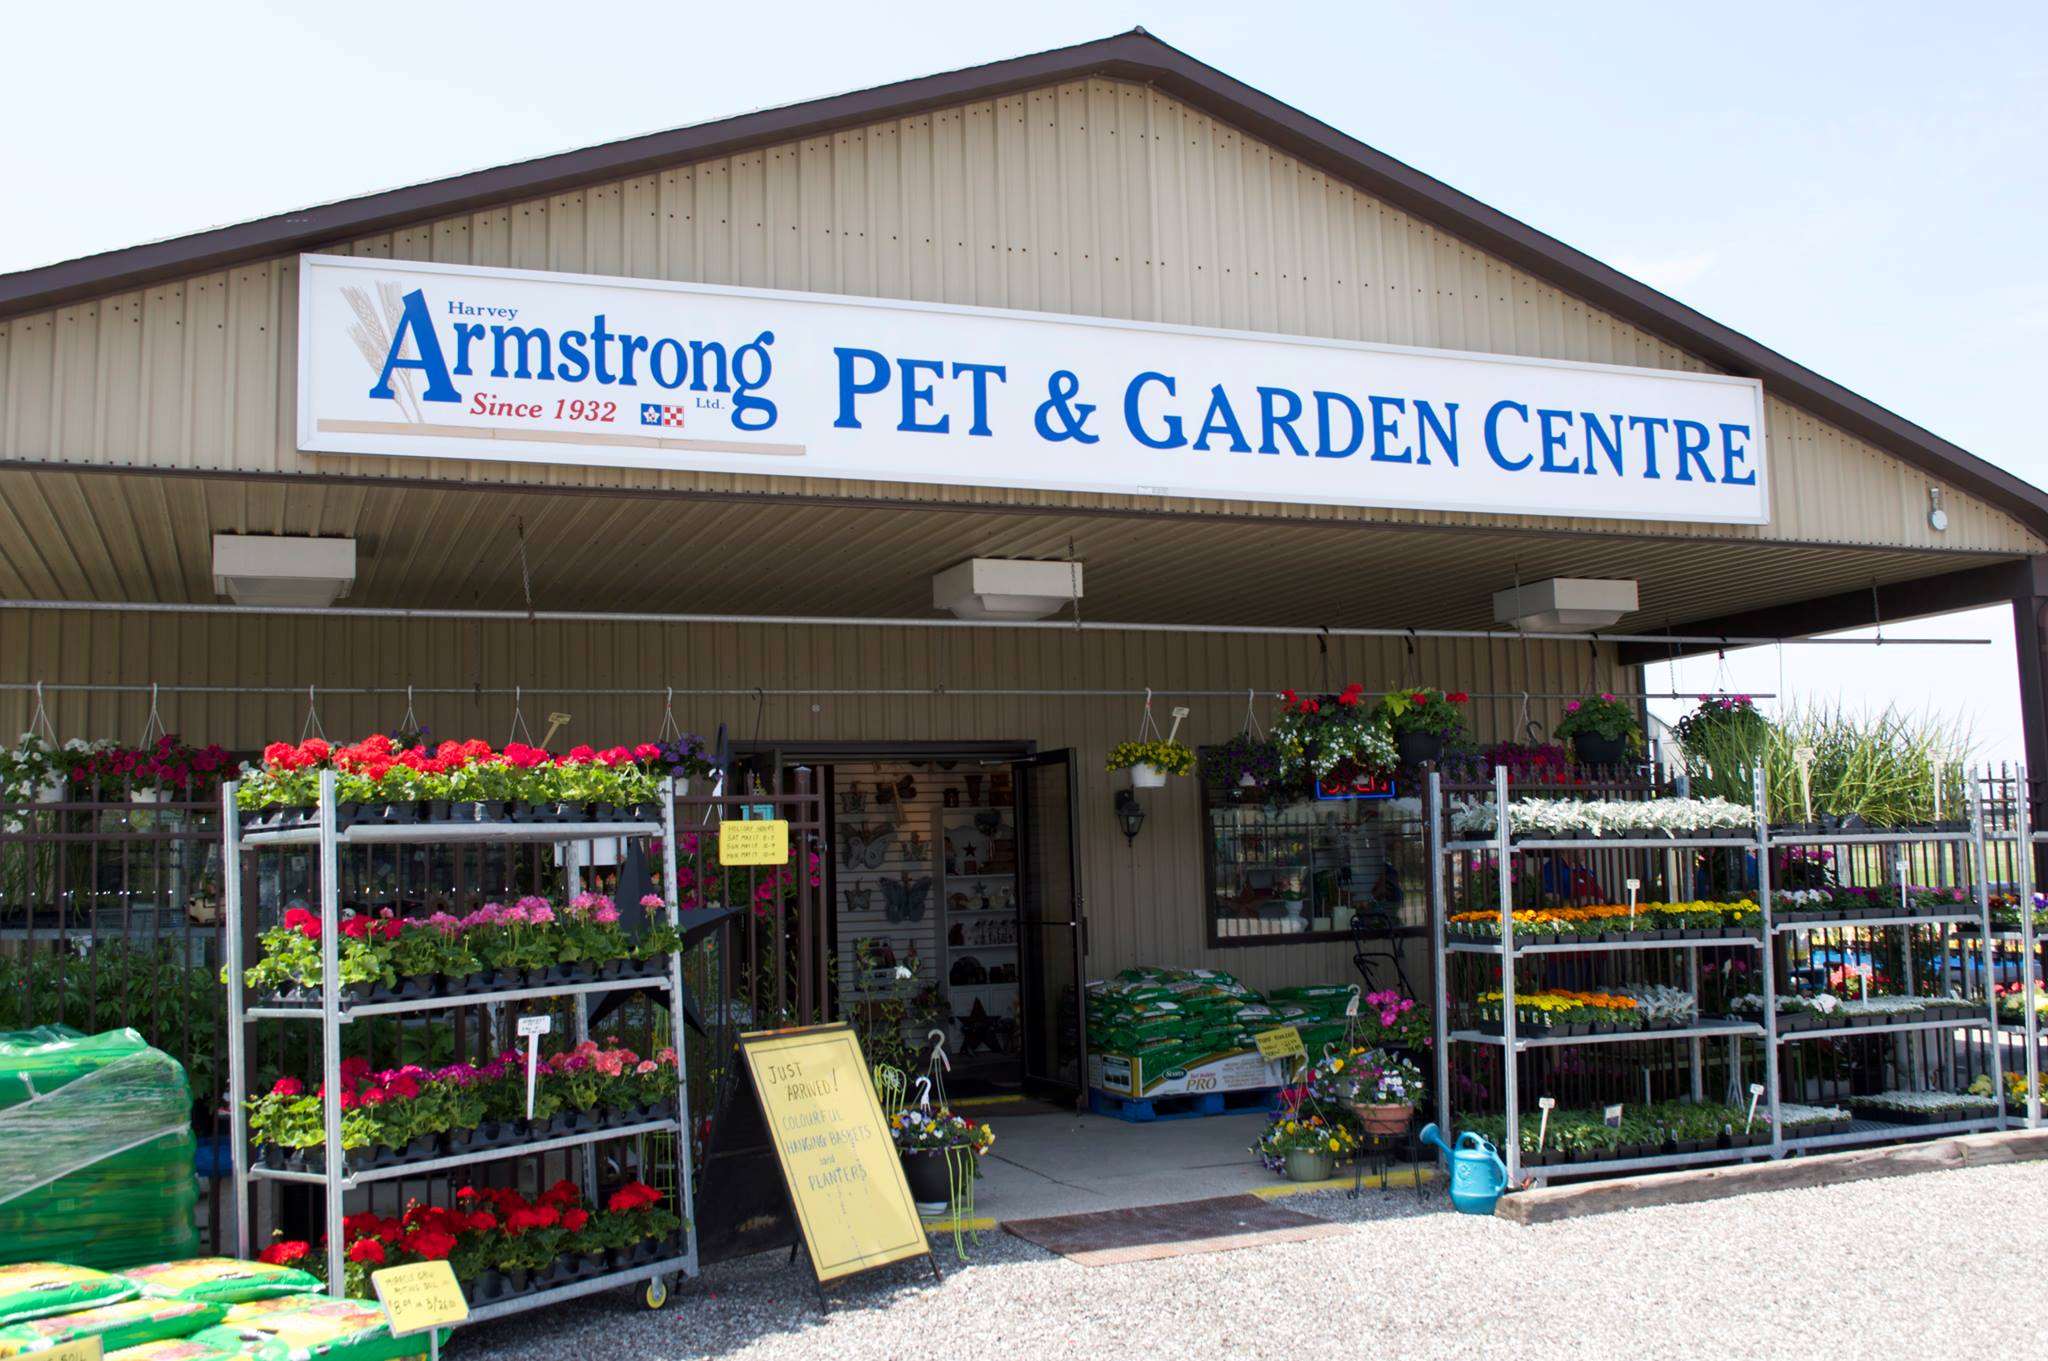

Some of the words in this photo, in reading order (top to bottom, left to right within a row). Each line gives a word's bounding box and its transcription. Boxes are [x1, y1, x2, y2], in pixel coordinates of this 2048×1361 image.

[447, 299, 519, 322] Harvey
[369, 287, 778, 432] Armstrong
[469, 392, 543, 420] Since
[554, 398, 617, 423] 1932
[695, 397, 726, 410] Ltd.
[833, 346, 1007, 437] PET
[1034, 369, 1100, 444] &
[1123, 370, 1460, 467] GARDEN
[1483, 399, 1757, 486] CENTRE
[769, 1062, 802, 1084] JUST
[788, 1067, 838, 1101] ARRIVED!
[1186, 1077, 1217, 1091] PRO
[808, 1167, 867, 1190] PLANTERS
